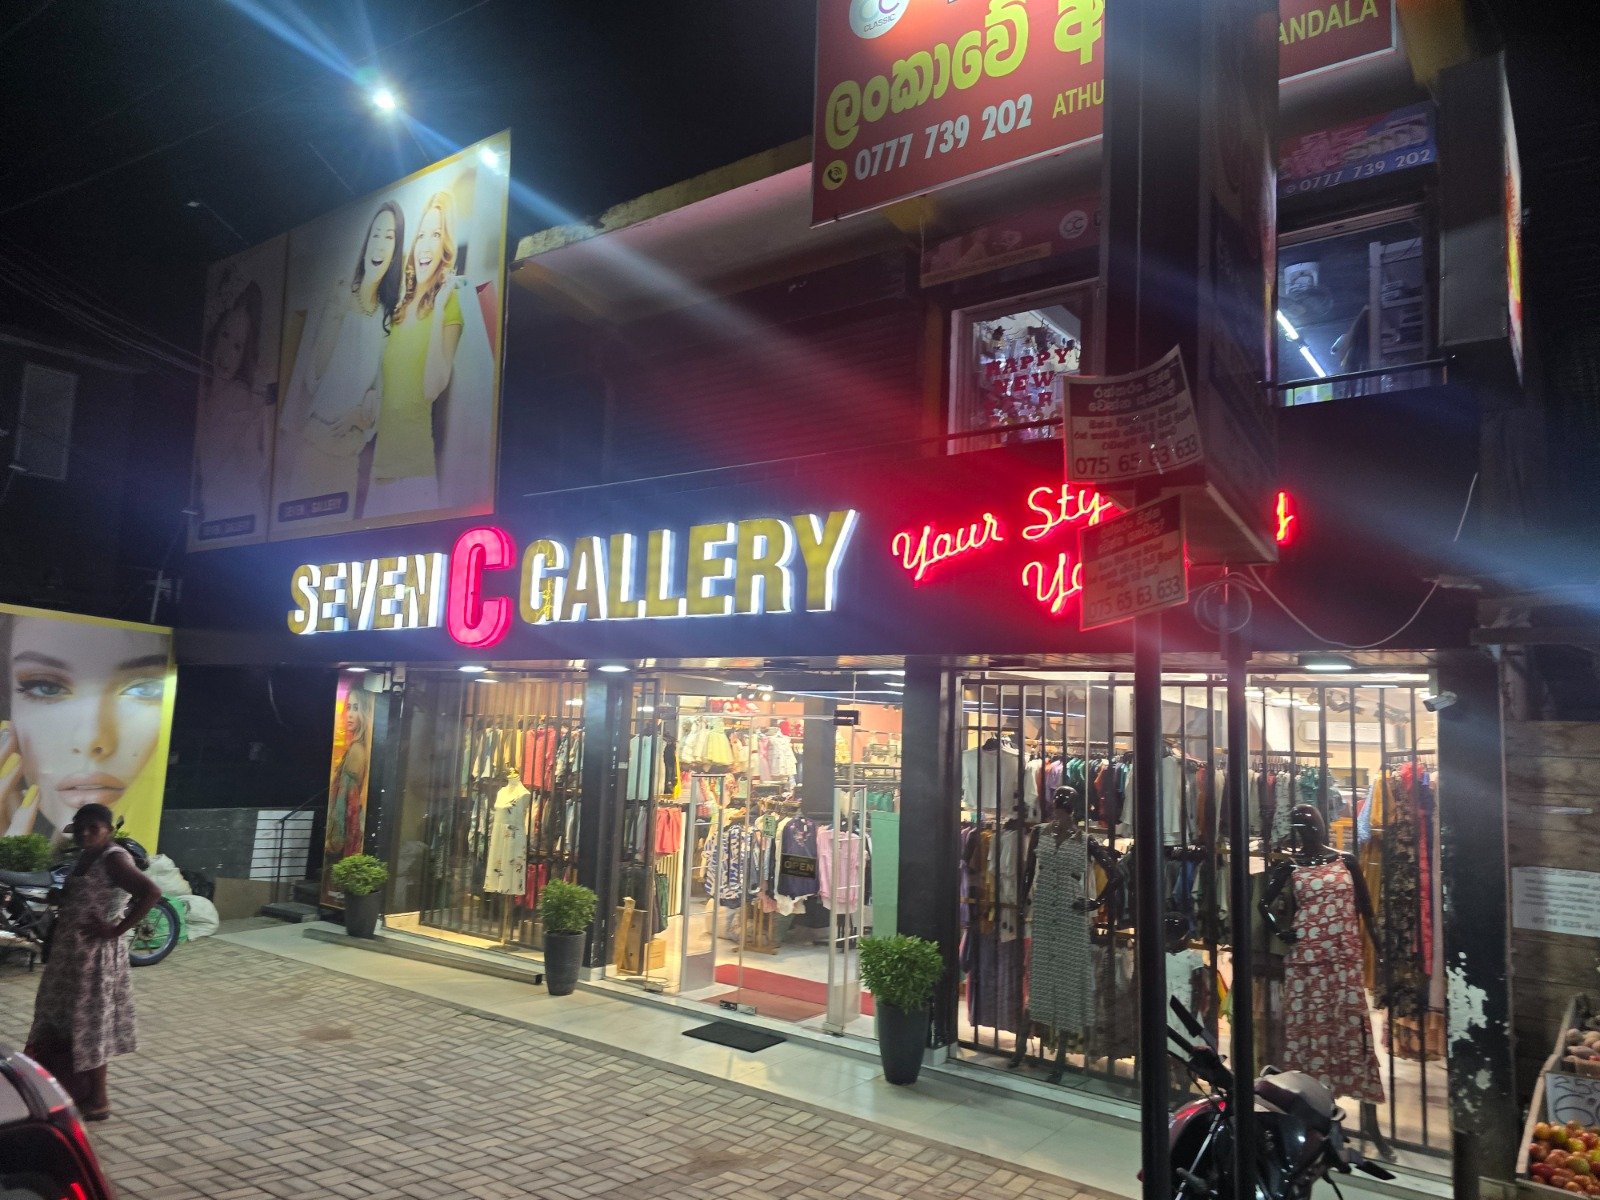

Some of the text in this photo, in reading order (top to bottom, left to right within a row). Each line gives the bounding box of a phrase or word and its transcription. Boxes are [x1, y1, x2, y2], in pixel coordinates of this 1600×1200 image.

[863, 13, 896, 32] CLASSIC
[854, 93, 1033, 181] 0777 739 202
[1300, 148, 1431, 192] 0777 739 202
[1075, 456, 1110, 475] 075
[1118, 452, 1140, 473] 65
[1175, 433, 1199, 459] 633
[892, 512, 1004, 581] Your
[1022, 483, 1113, 540] Sty
[286, 508, 861, 649] SEVEN C GALLERY
[1116, 590, 1133, 611] 65
[1136, 585, 1153, 606] 63
[1156, 575, 1182, 600] 633
[784, 860, 815, 872] OPEN
